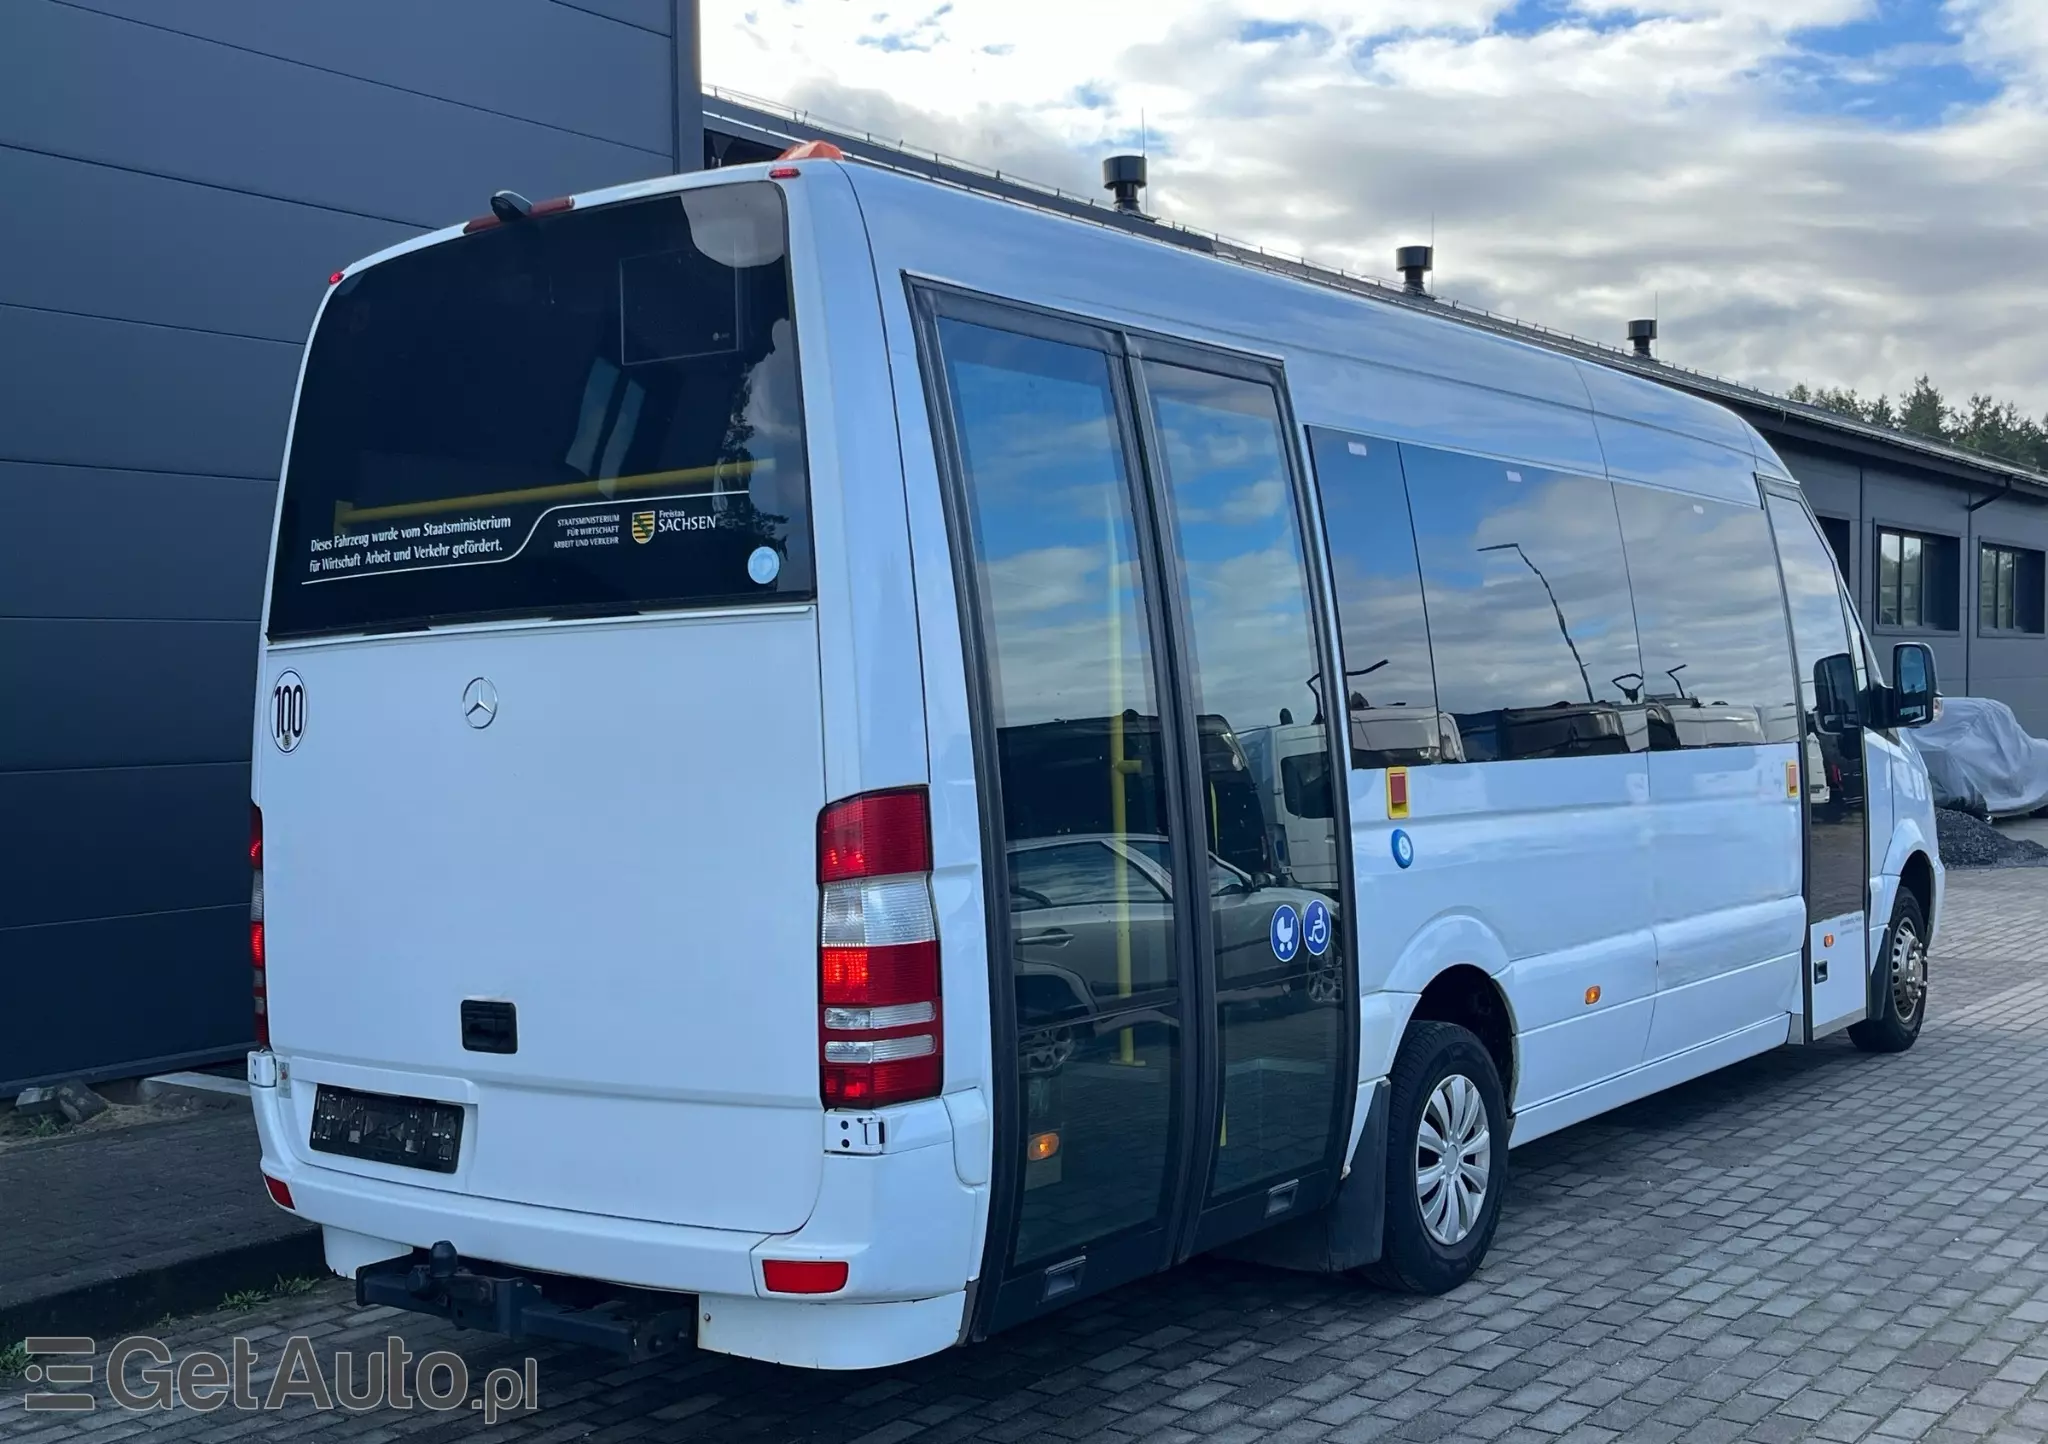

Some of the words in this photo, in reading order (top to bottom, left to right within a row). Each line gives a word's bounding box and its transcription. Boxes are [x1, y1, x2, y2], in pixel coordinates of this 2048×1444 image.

[557, 514, 620, 527] STAATSMINISTERIUM
[658, 515, 716, 532] SACHSEN
[310, 538, 333, 552] Dieses
[334, 534, 369, 548] Fahrzeug
[371, 527, 399, 542] wurde
[401, 527, 420, 539] vom
[423, 515, 511, 537] Staatsministerium
[566, 527, 579, 537] FÜR
[580, 525, 620, 535] WIRTSCHAFT
[553, 539, 575, 549] ARBEIT
[575, 539, 589, 547] UND
[590, 536, 619, 546] VERKEHR
[309, 559, 321, 573] für
[321, 553, 361, 570] Wirtschaft
[365, 549, 391, 564] Arbeit
[393, 546, 411, 561] und
[413, 543, 450, 559] Verkehr
[452, 538, 503, 559] gefördert.
[274, 684, 303, 738] 100
